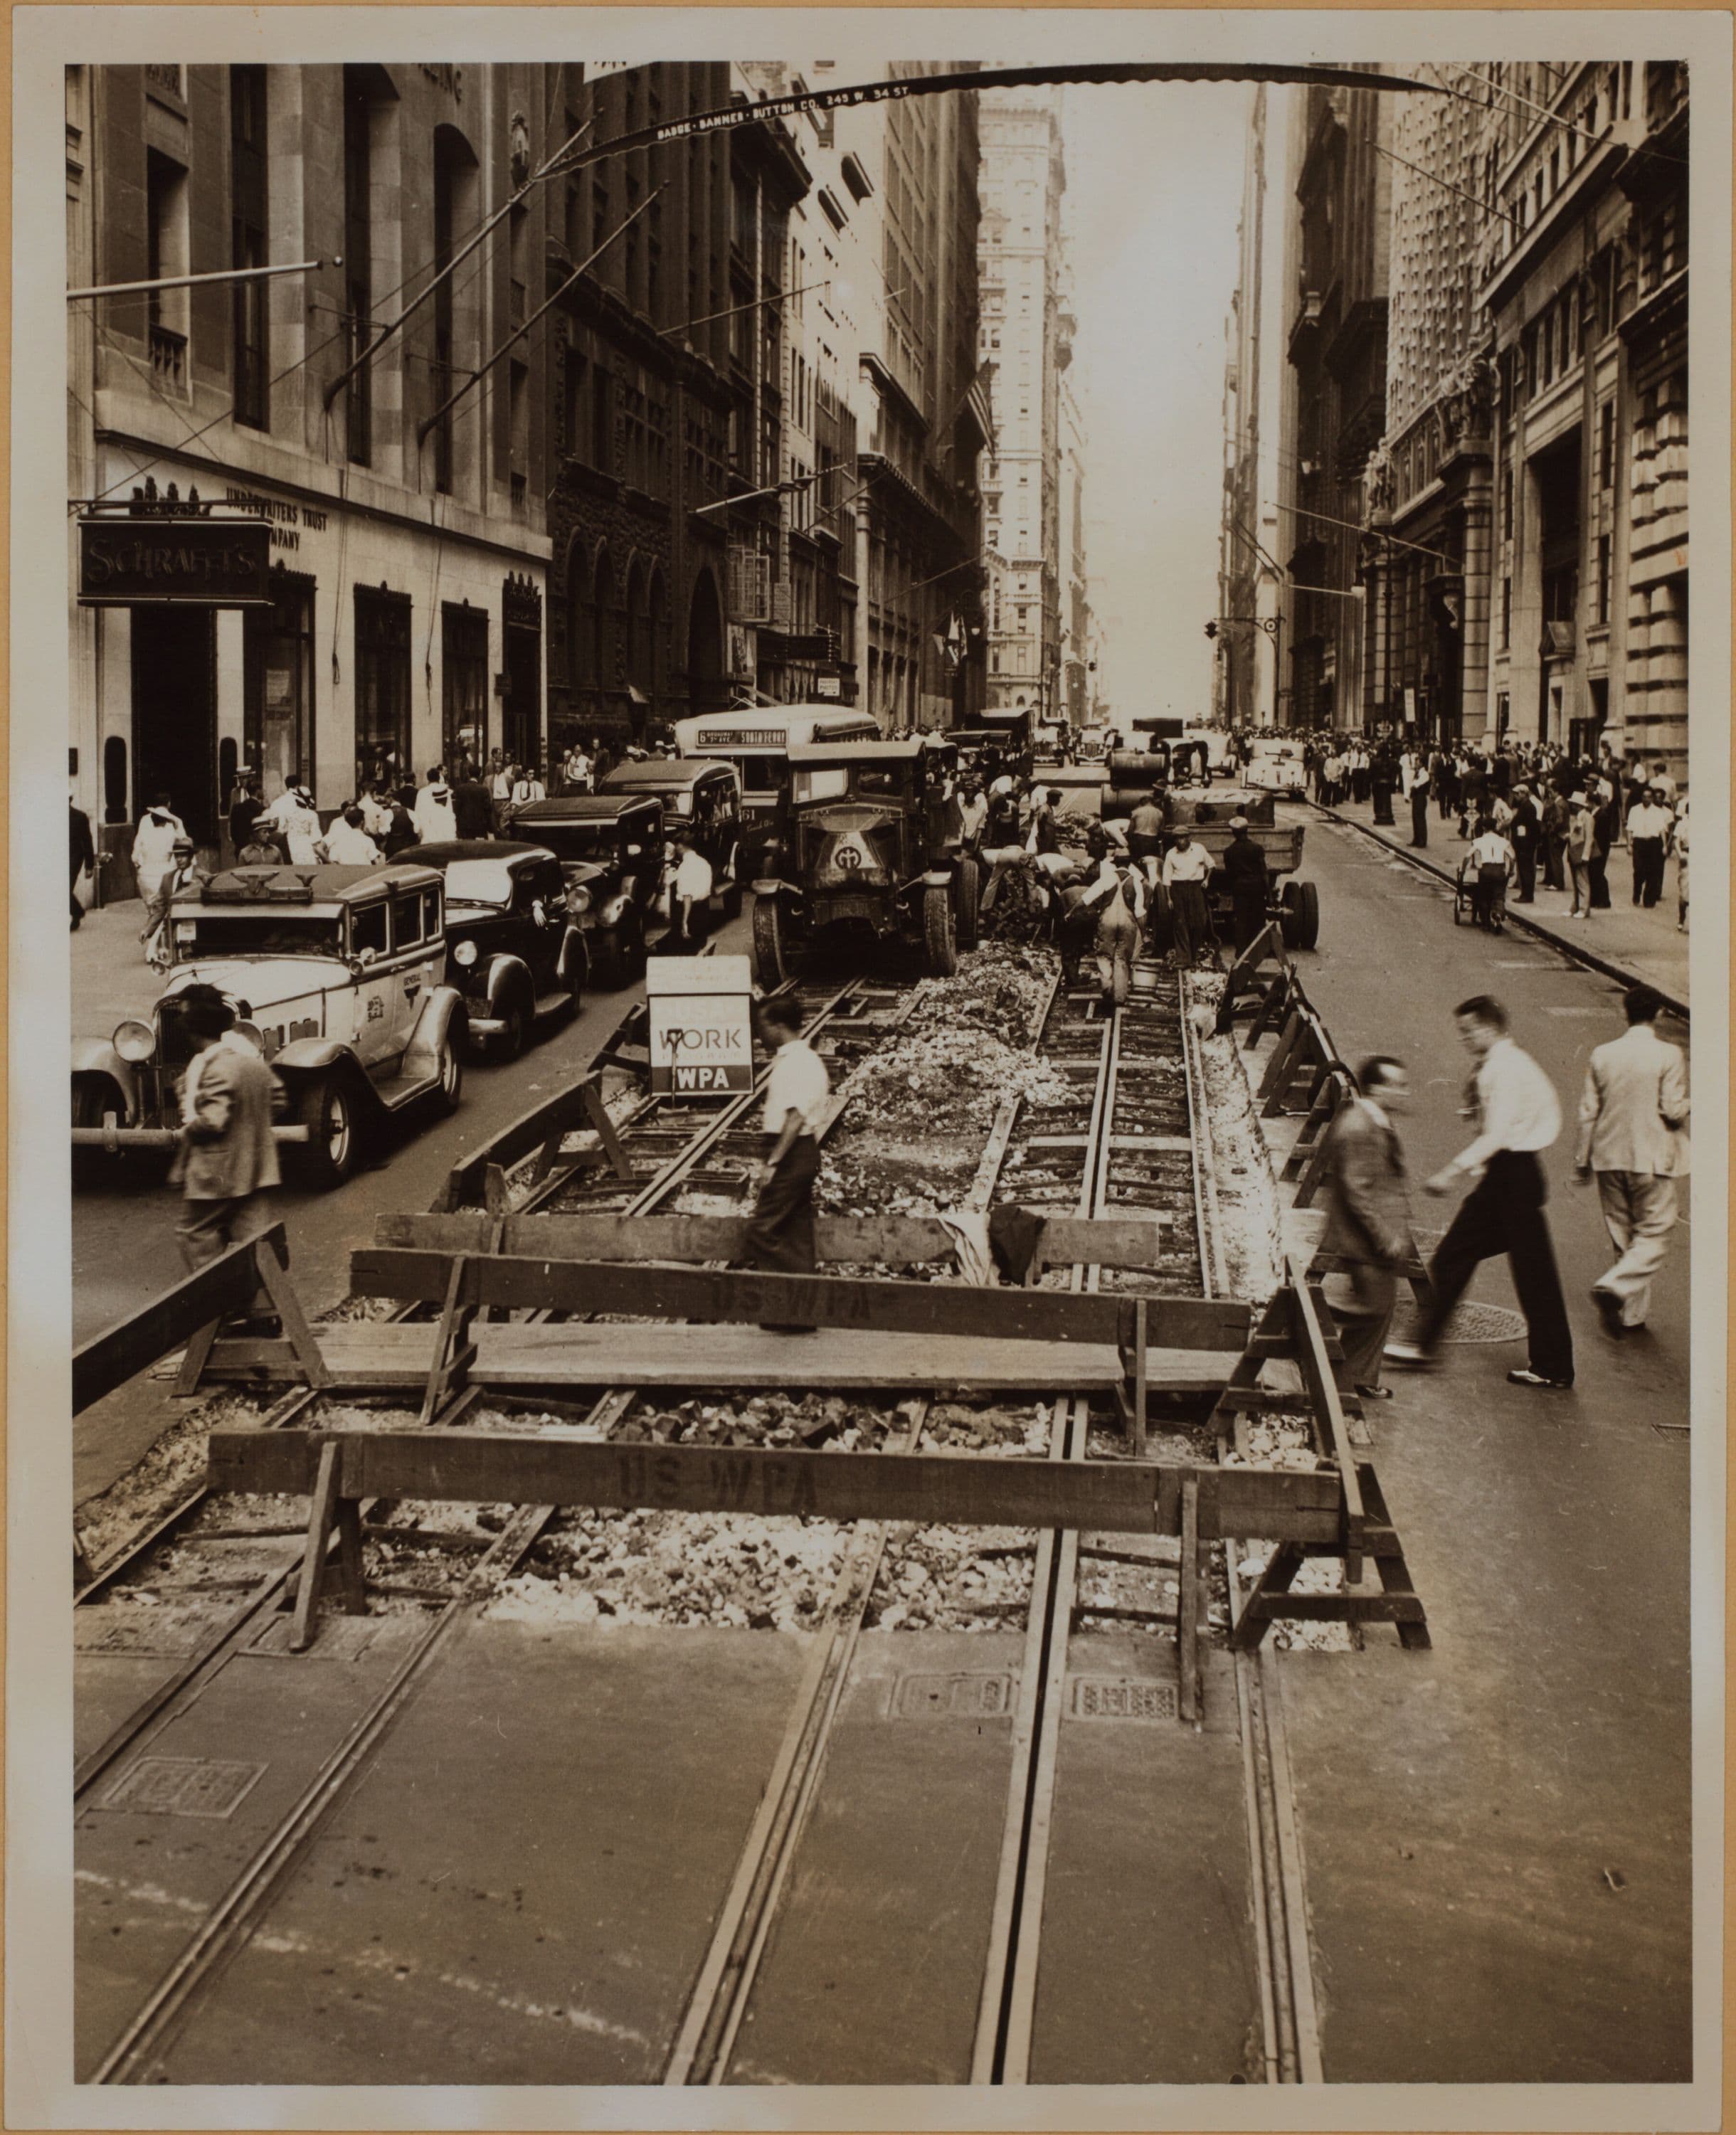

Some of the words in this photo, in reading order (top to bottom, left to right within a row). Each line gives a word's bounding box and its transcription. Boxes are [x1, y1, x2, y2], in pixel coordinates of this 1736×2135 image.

[657, 122, 692, 140] BADGE
[699, 112, 744, 129] BANNER
[753, 103, 795, 119] BUTTON
[302, 509, 327, 532] TRUST
[270, 527, 300, 551] MPANY
[700, 731, 706, 743] 6
[659, 1029, 741, 1049] WORK
[677, 1068, 729, 1088] WPA
[786, 1281, 870, 1318] WPA
[620, 1455, 679, 1502] US
[711, 1460, 816, 1508] WPA
